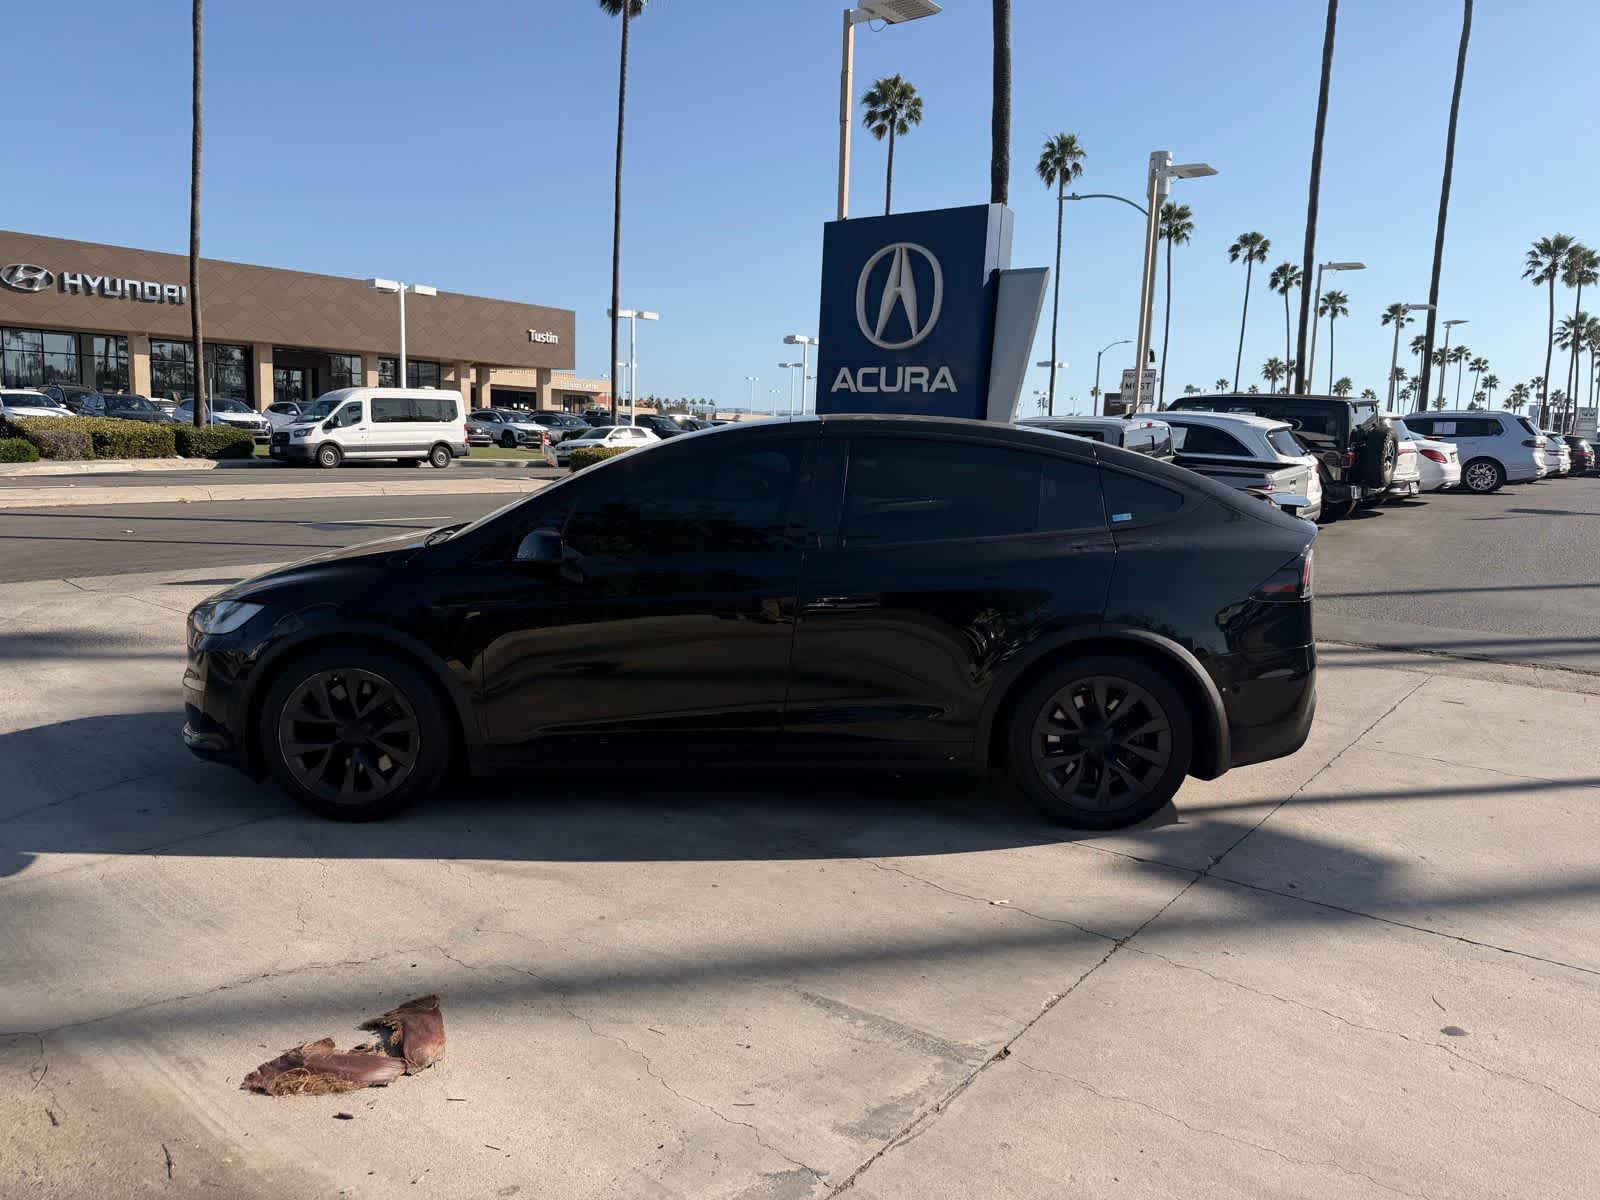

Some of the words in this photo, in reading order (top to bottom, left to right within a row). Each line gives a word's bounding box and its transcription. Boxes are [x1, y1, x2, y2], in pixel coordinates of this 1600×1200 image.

[63, 271, 188, 303] HYUNDAI
[528, 329, 559, 344] Tustin
[830, 366, 958, 393] ACURA
